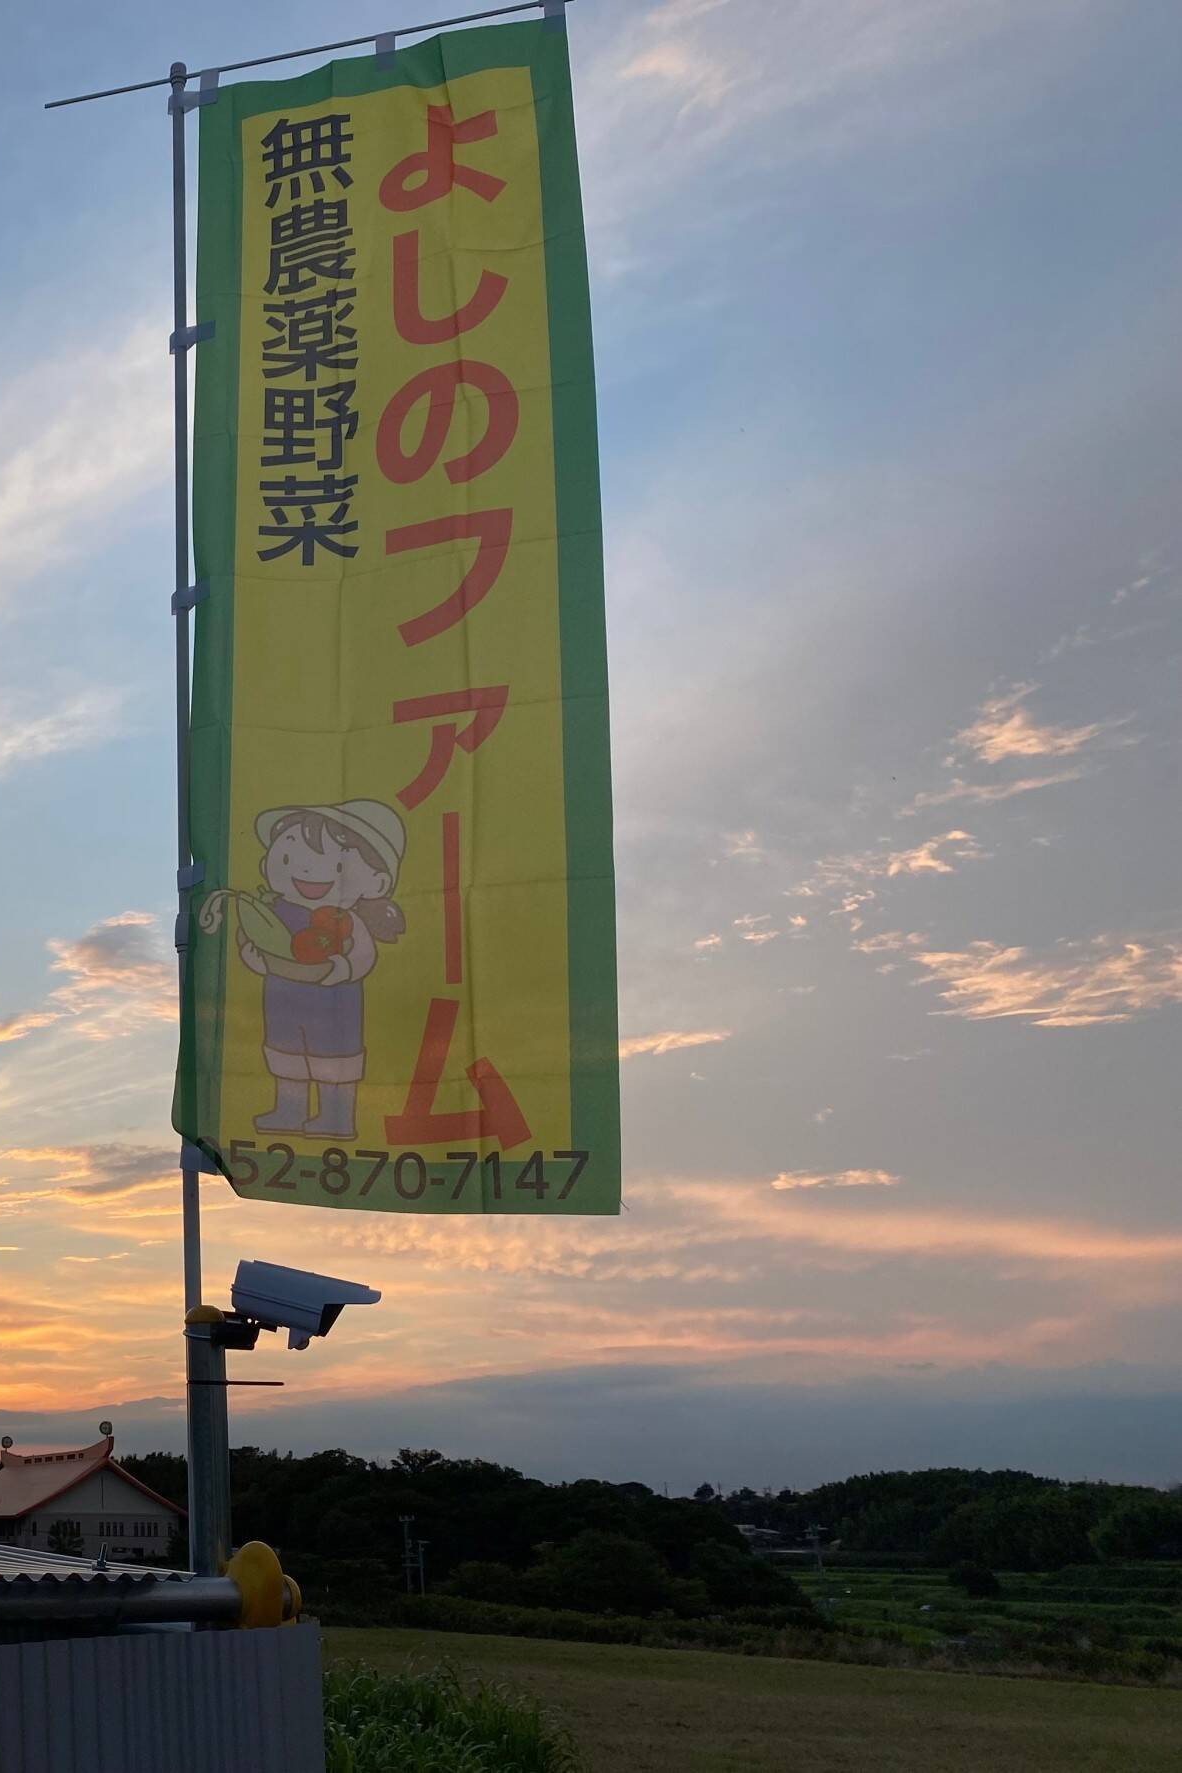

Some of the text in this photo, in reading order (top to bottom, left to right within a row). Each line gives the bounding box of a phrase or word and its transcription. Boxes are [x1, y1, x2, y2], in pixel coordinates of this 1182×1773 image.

[258, 114, 359, 566] 無農薬野菜
[376, 104, 532, 1151] よしのファーム
